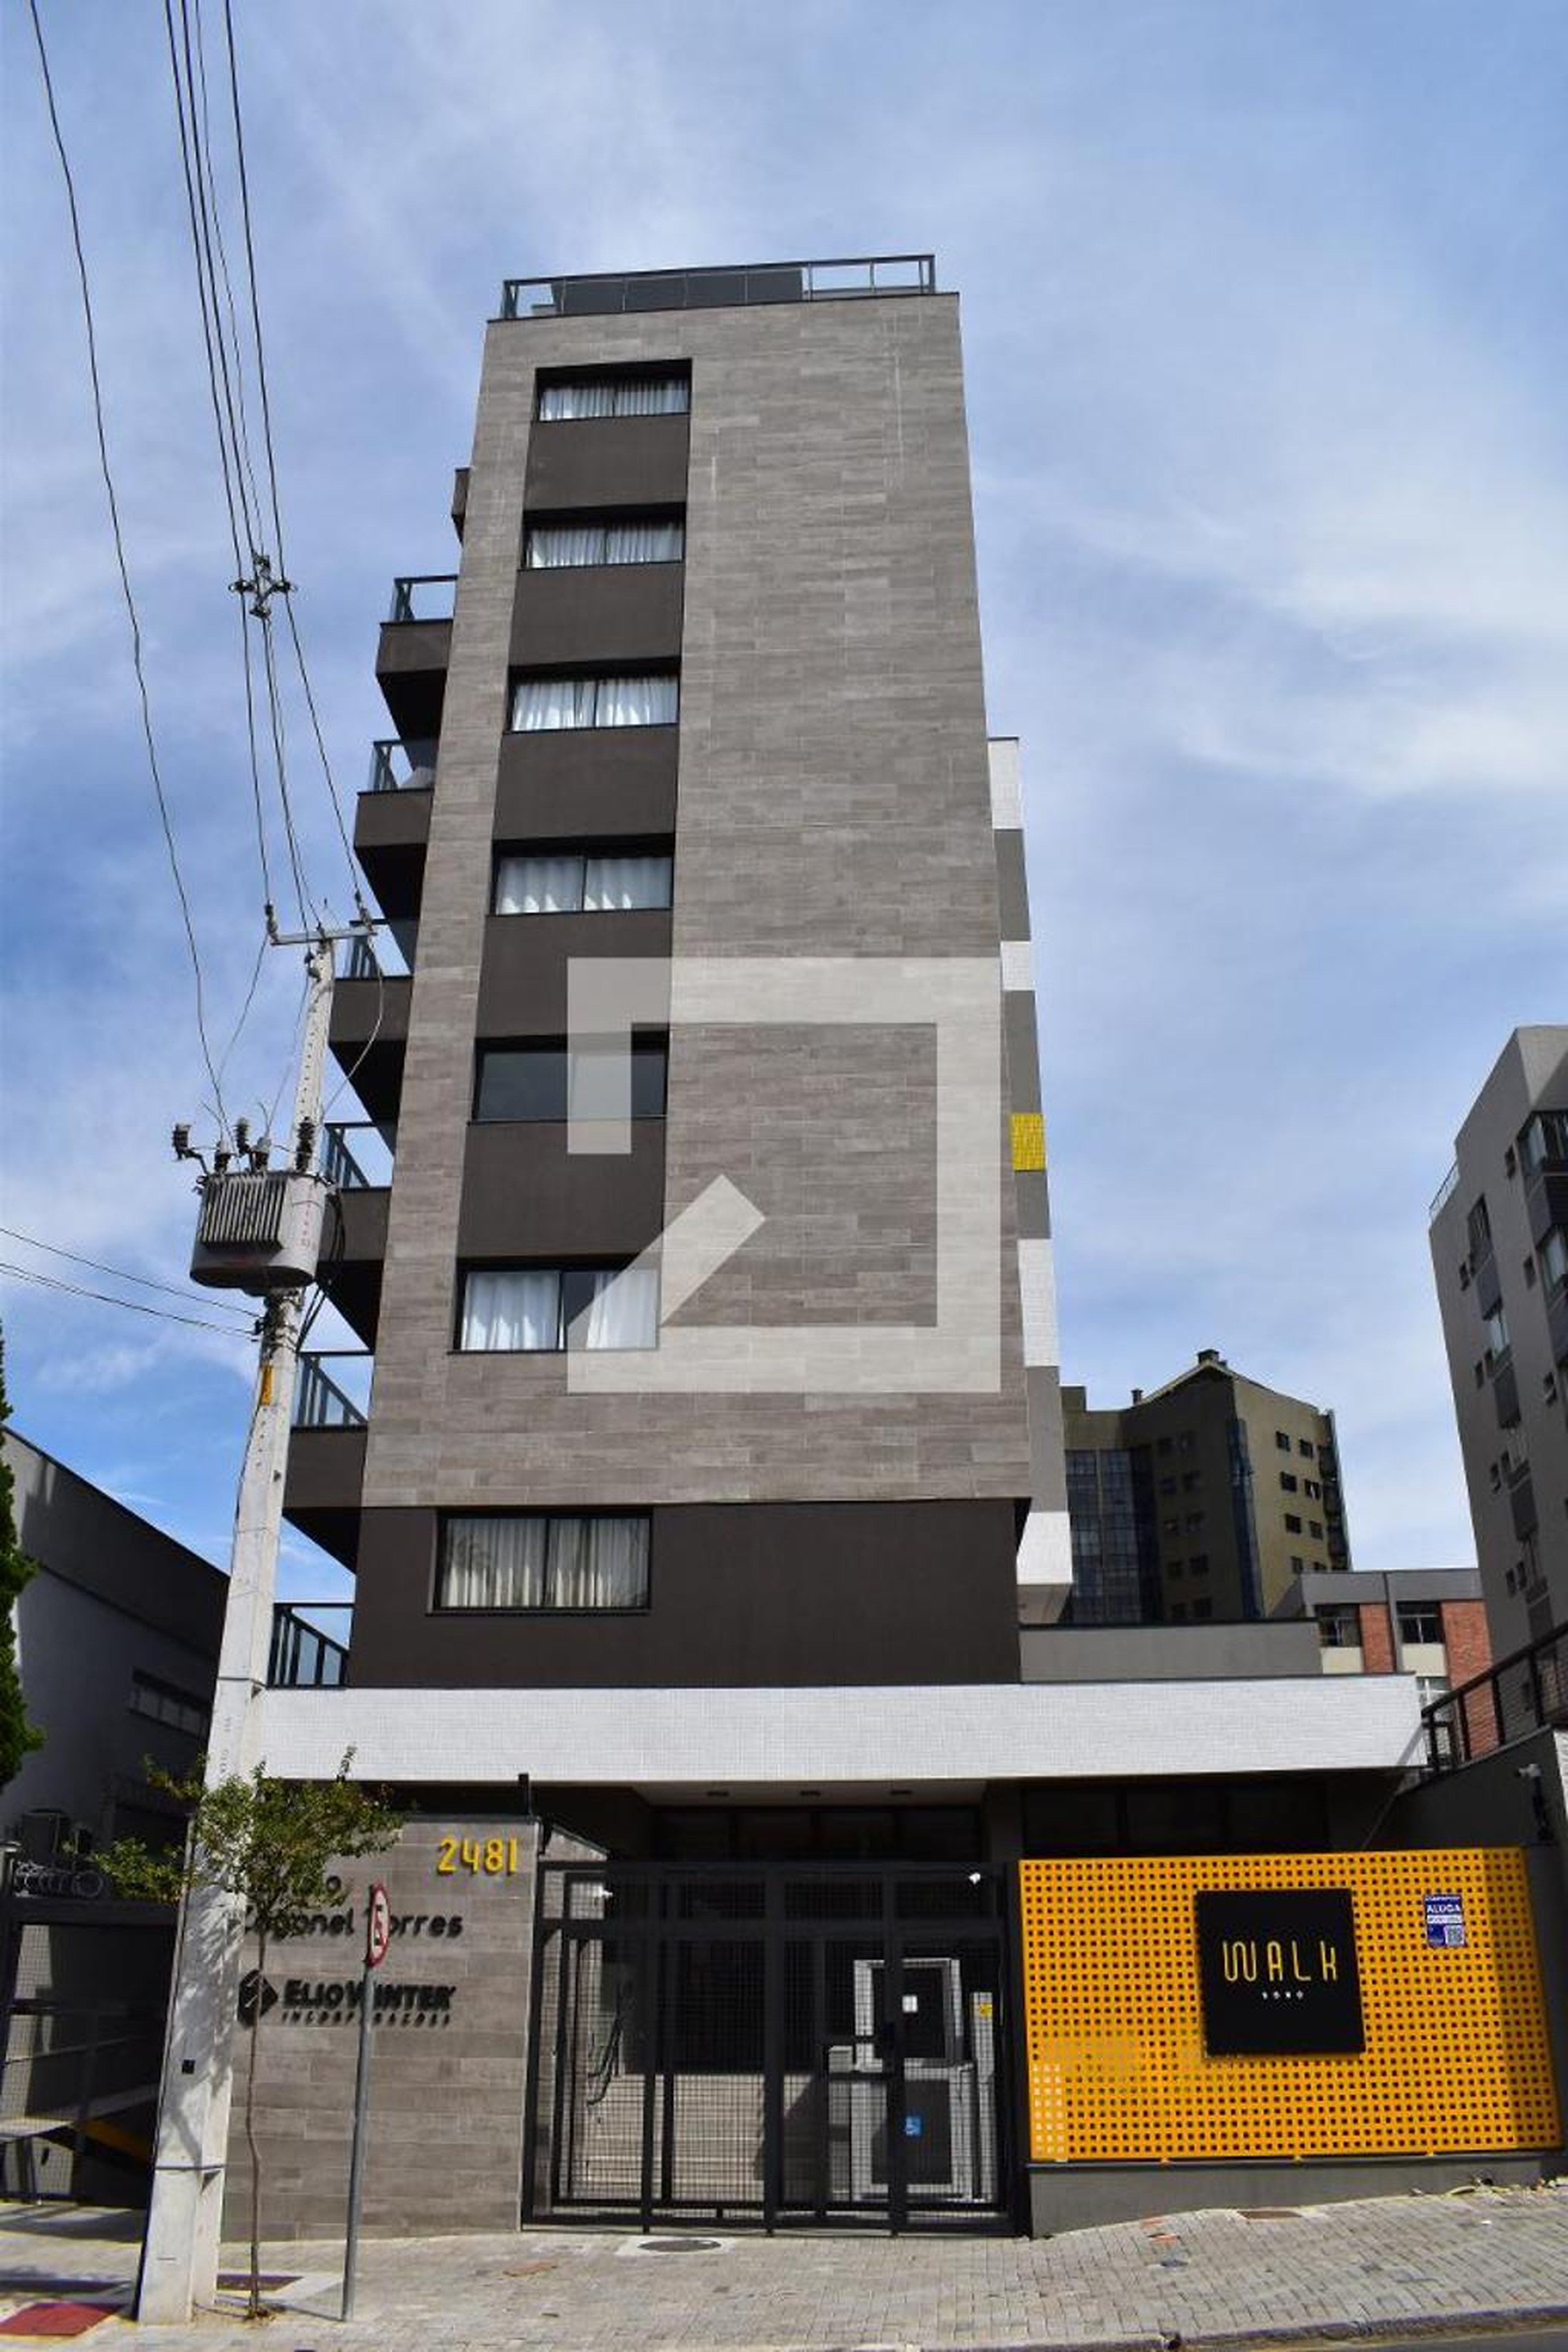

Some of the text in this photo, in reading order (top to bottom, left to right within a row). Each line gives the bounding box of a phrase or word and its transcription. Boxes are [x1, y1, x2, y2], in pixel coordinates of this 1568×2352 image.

[438, 1837, 518, 1875] 2481
[363, 1906, 463, 1938] orres
[1427, 1904, 1461, 1913] ALUGA
